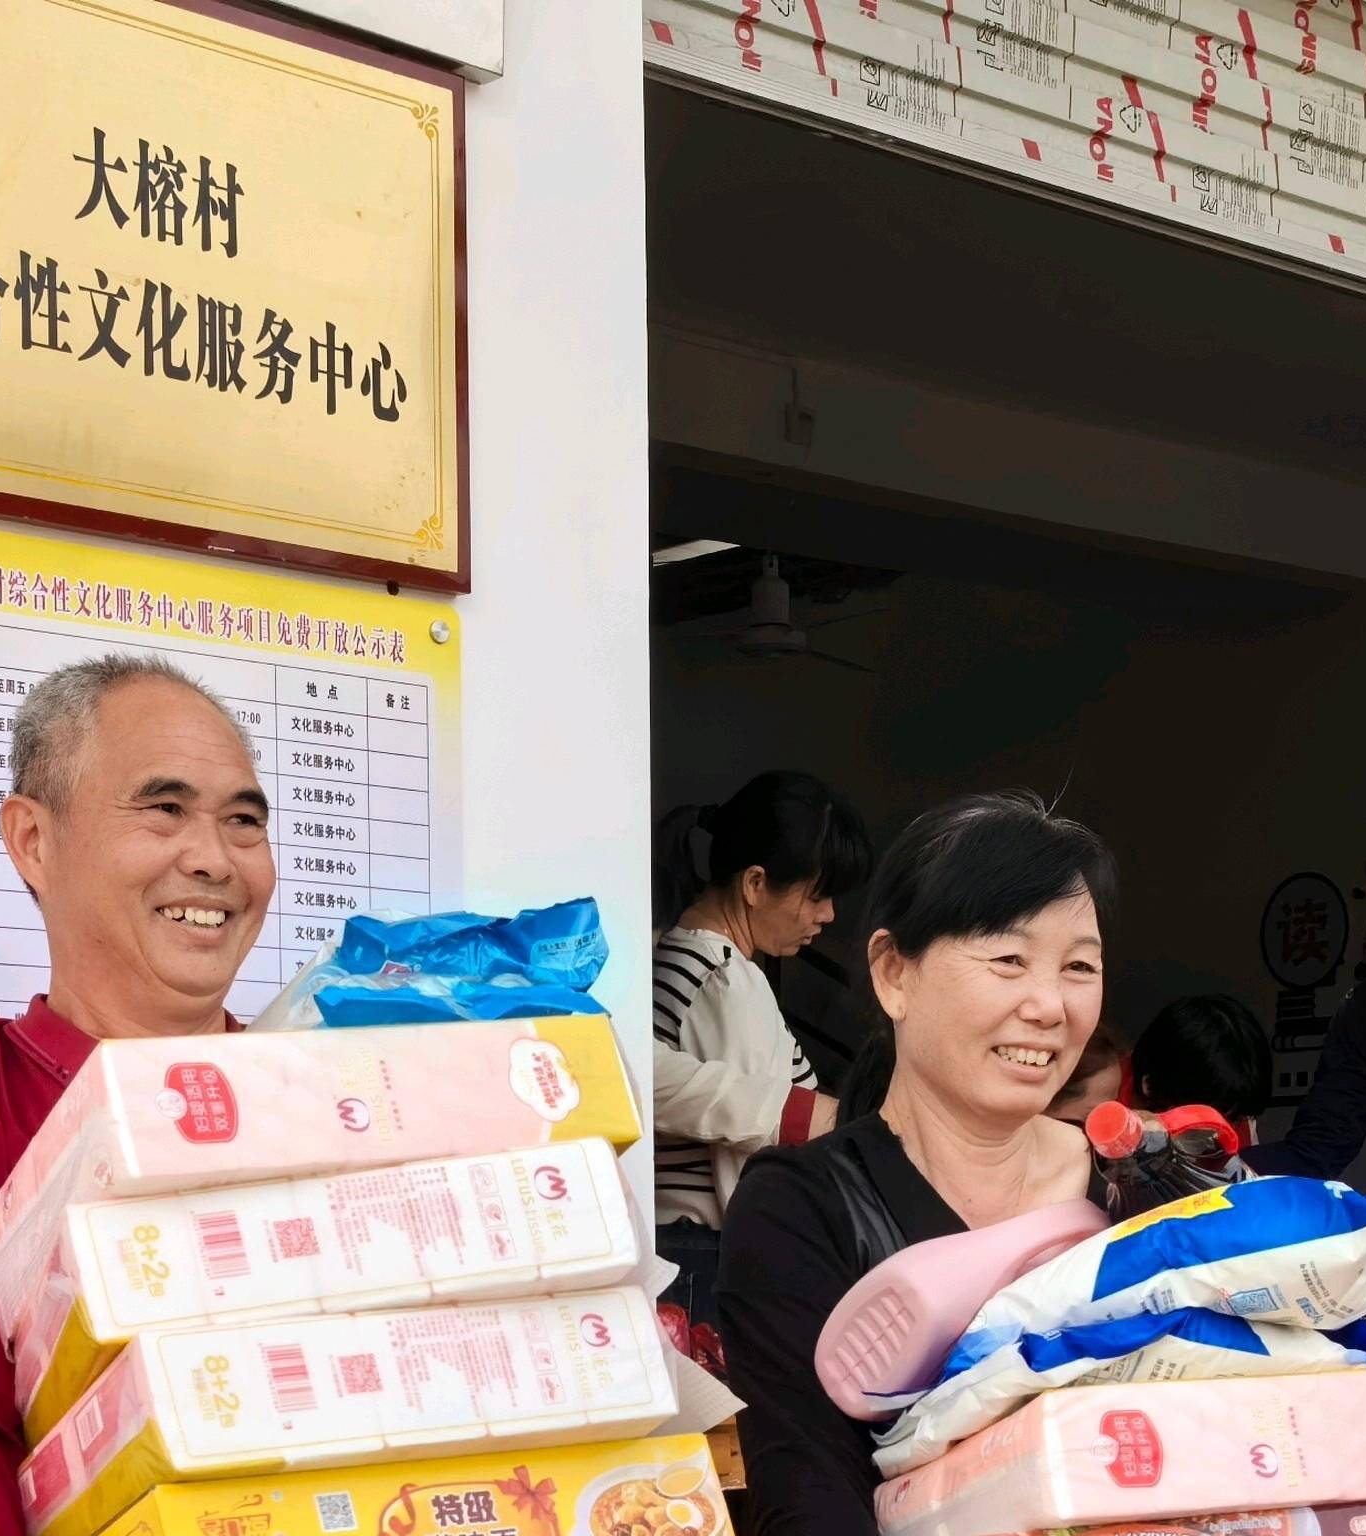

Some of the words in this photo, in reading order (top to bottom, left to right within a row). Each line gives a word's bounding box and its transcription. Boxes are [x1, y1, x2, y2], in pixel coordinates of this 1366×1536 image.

[72, 126, 246, 258] 大榕村
[291, 716, 355, 738] 文化服务中心
[292, 752, 355, 772] 文化服务中心
[292, 786, 356, 807] 文化服务中心
[293, 821, 356, 841] 文化服务中心
[293, 856, 357, 876] 文化服务中心
[294, 891, 357, 909] 文化服务中心
[1277, 898, 1330, 968] 读
[511, 1158, 536, 1207] LOTUS
[431, 1490, 497, 1527] 特级
